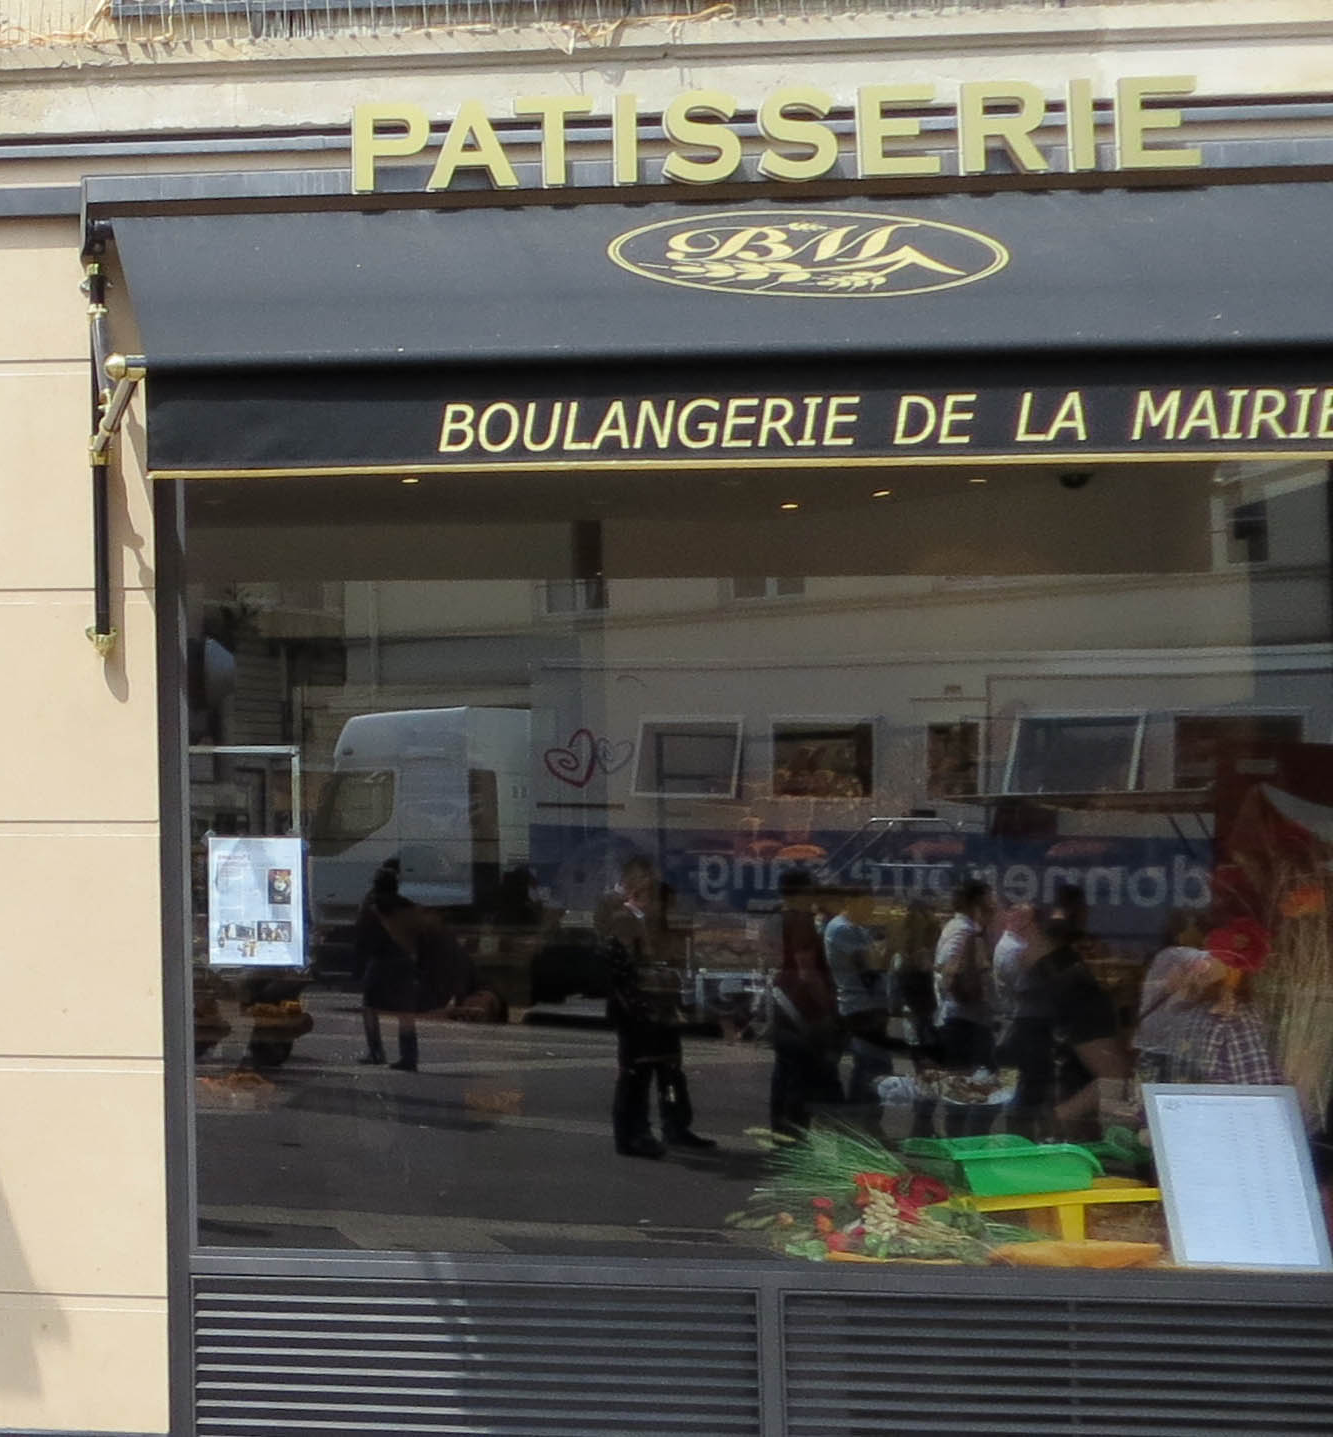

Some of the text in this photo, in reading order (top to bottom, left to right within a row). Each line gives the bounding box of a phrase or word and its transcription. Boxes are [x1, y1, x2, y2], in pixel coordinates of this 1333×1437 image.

[351, 75, 1202, 195] PATISSERIE
[438, 395, 860, 453] BOULANGERIE
[892, 393, 977, 445] DE
[1014, 391, 1089, 442] LA
